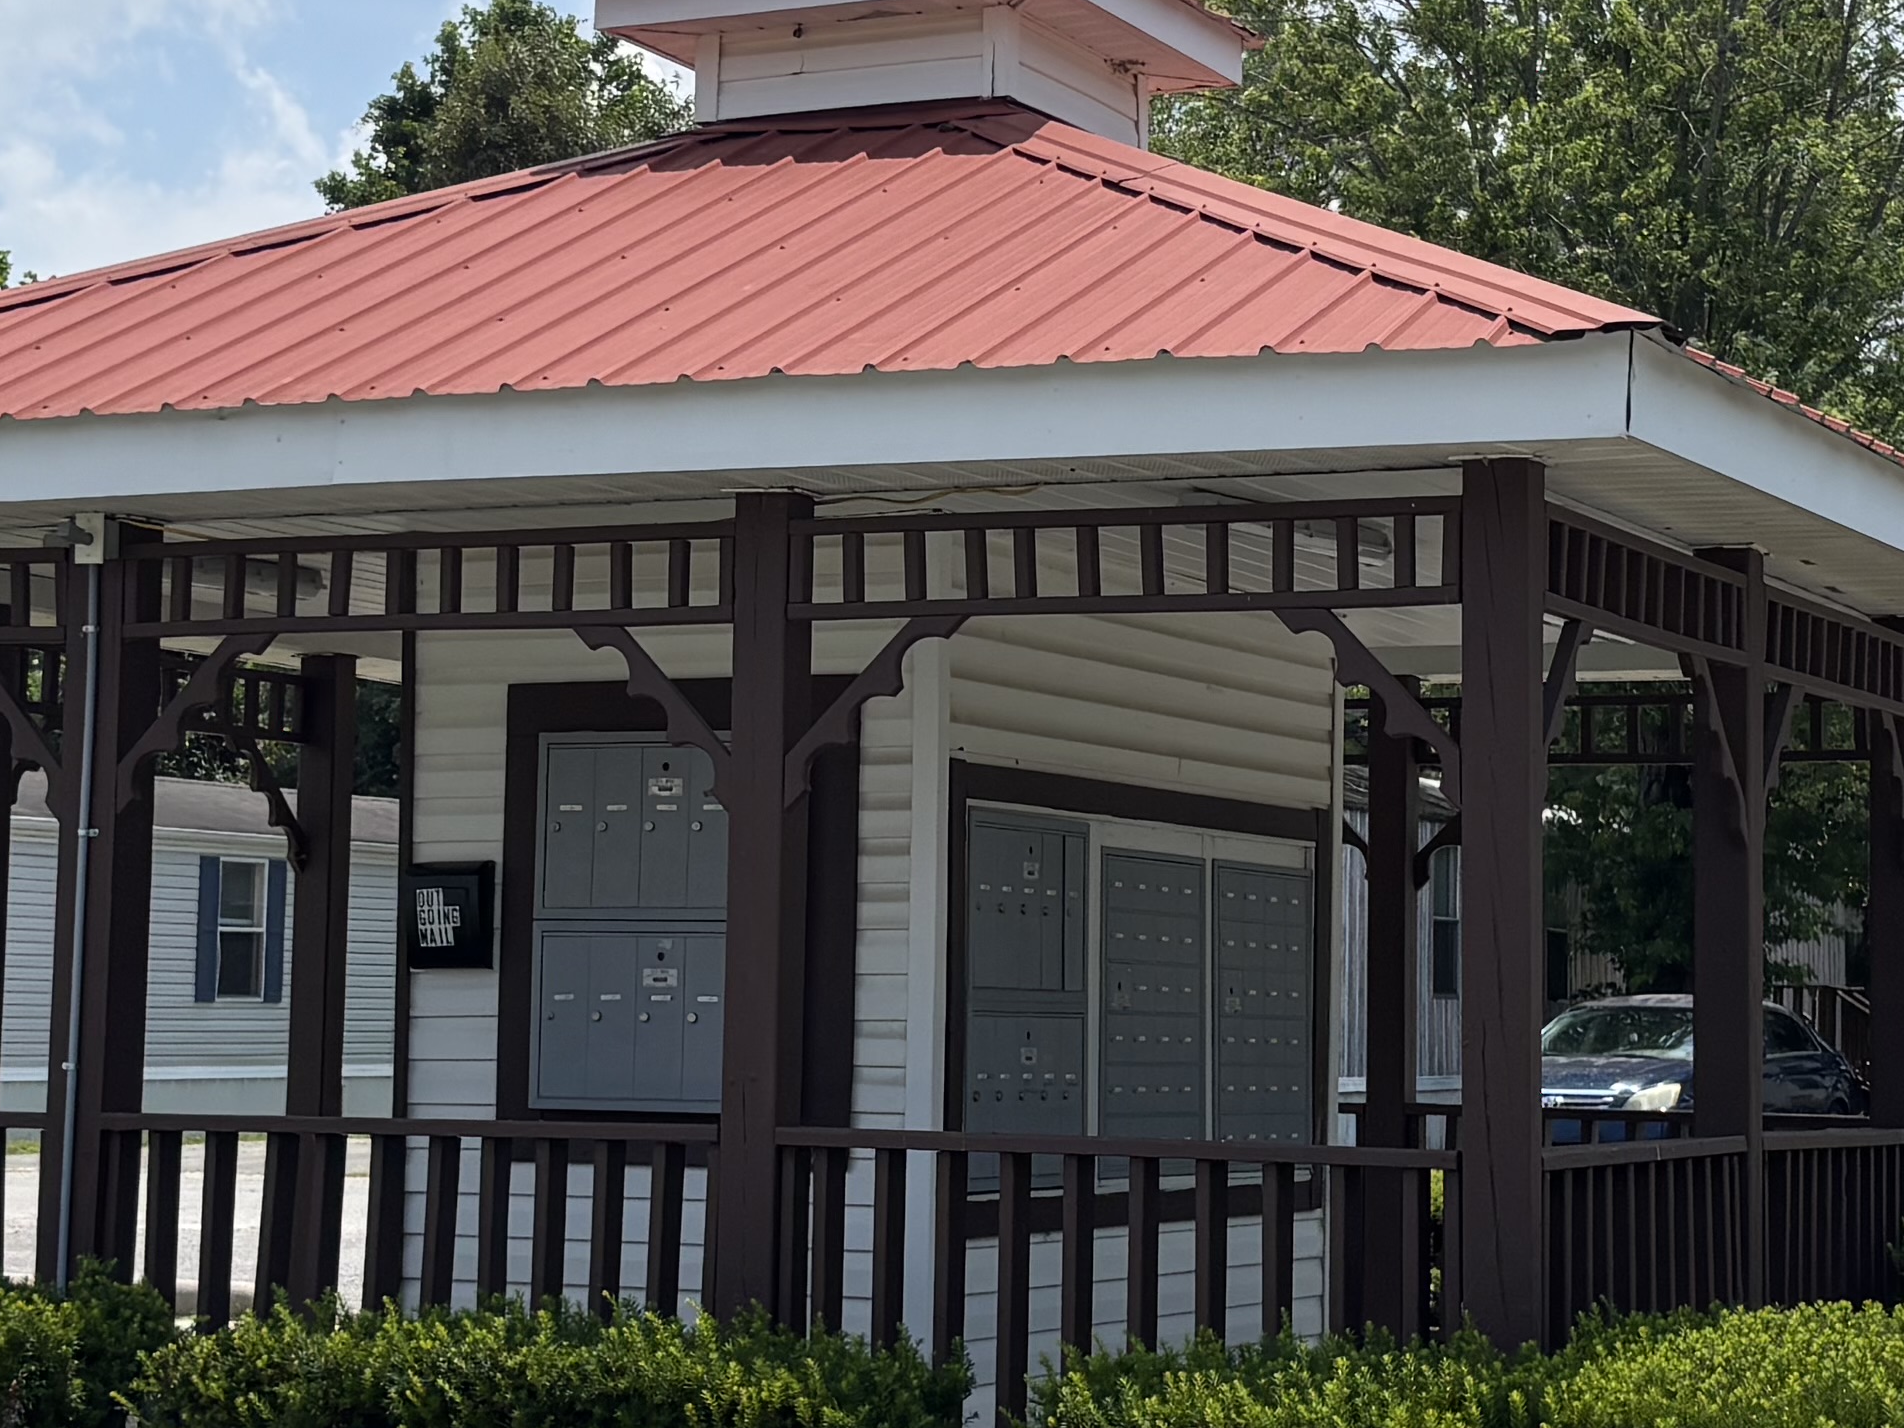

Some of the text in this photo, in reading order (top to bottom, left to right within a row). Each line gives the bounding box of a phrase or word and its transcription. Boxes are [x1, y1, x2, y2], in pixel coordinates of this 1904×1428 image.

[418, 889, 442, 908] OUT
[419, 907, 459, 926] GOING
[419, 926, 453, 945] MAIL
